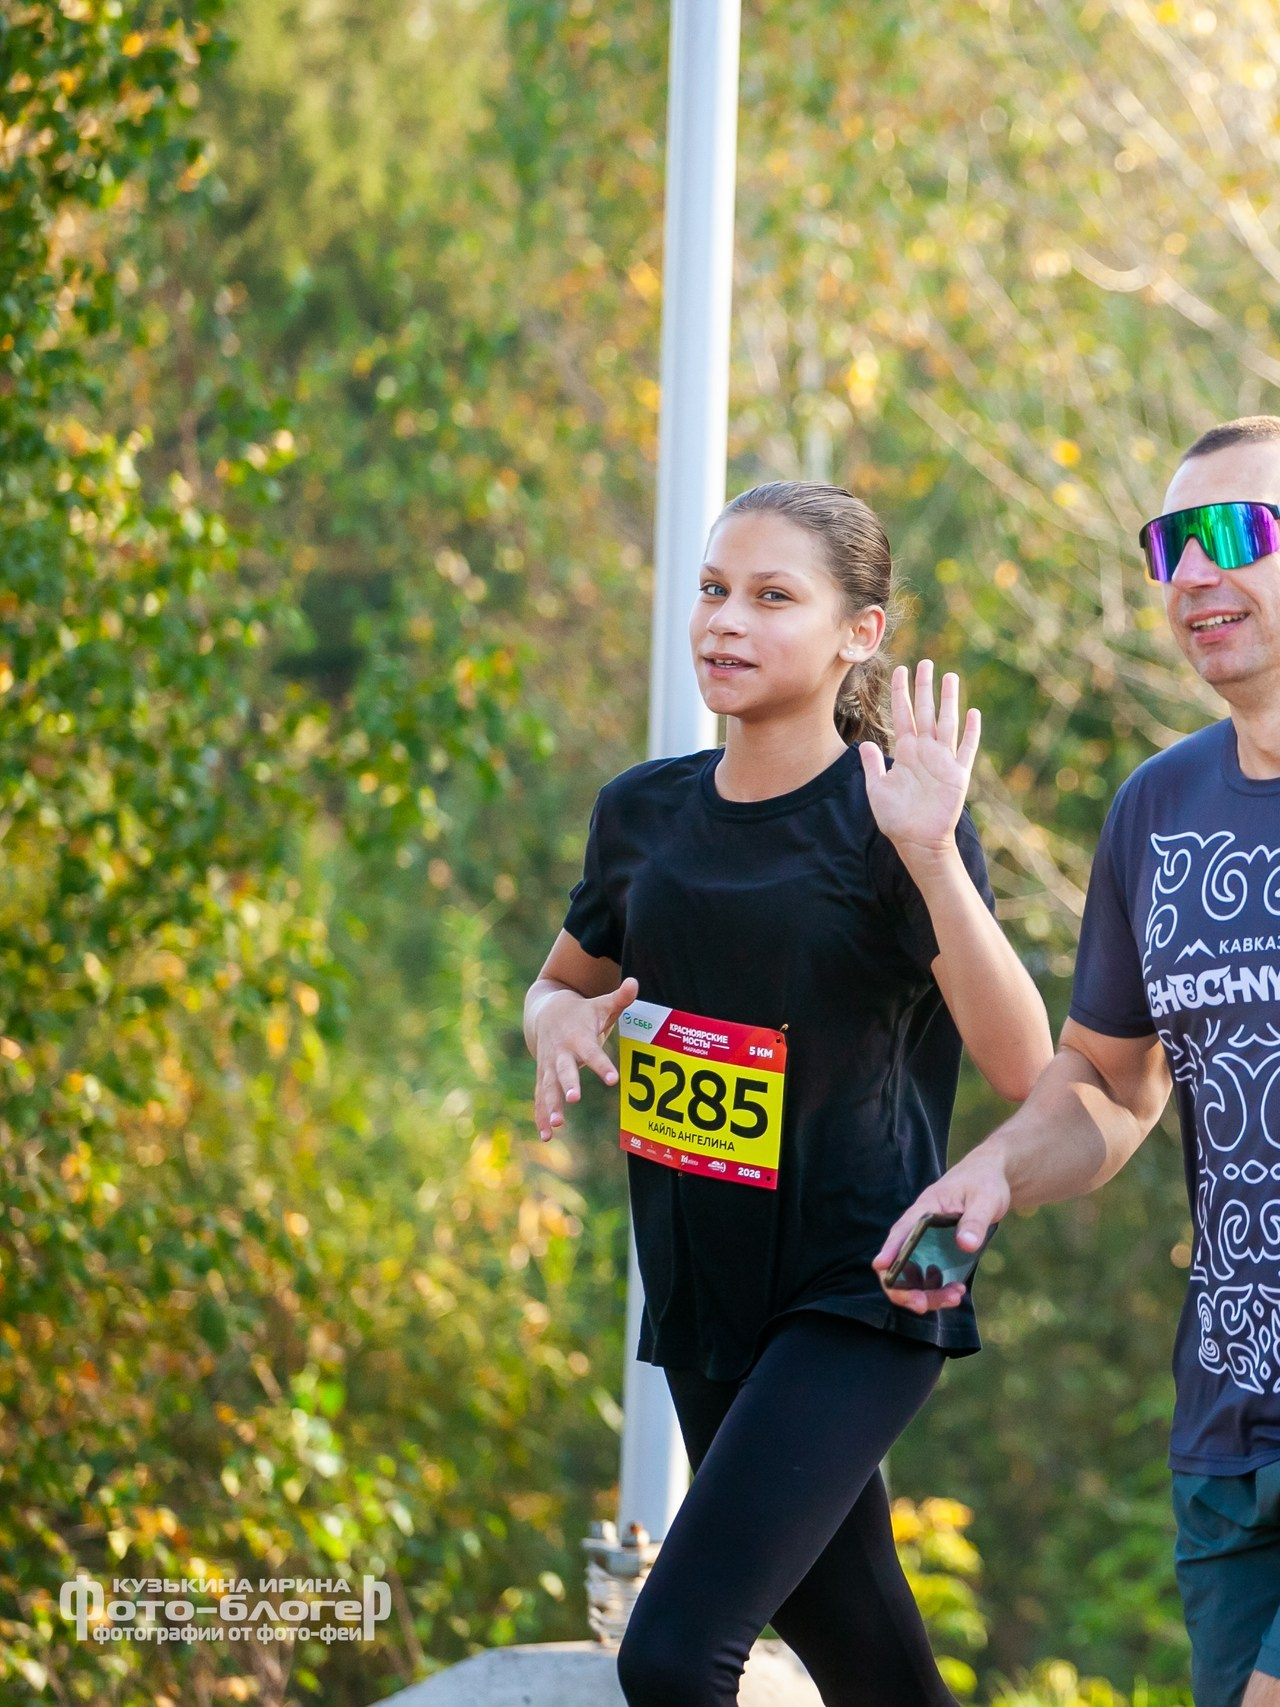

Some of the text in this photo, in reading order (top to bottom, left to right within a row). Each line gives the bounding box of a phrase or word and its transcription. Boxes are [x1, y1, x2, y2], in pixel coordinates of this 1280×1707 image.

[633, 1017, 653, 1031] СБЕР
[669, 1023, 728, 1044] КРАСНОЯРСКИЕ
[682, 1036, 711, 1049] МОСТЫ
[749, 1046, 773, 1059] 5 КМ
[628, 1049, 769, 1140] 5285
[648, 1120, 735, 1152] КАЙЛЬ АНГЕЛИНА
[737, 1167, 761, 1179] 2026
